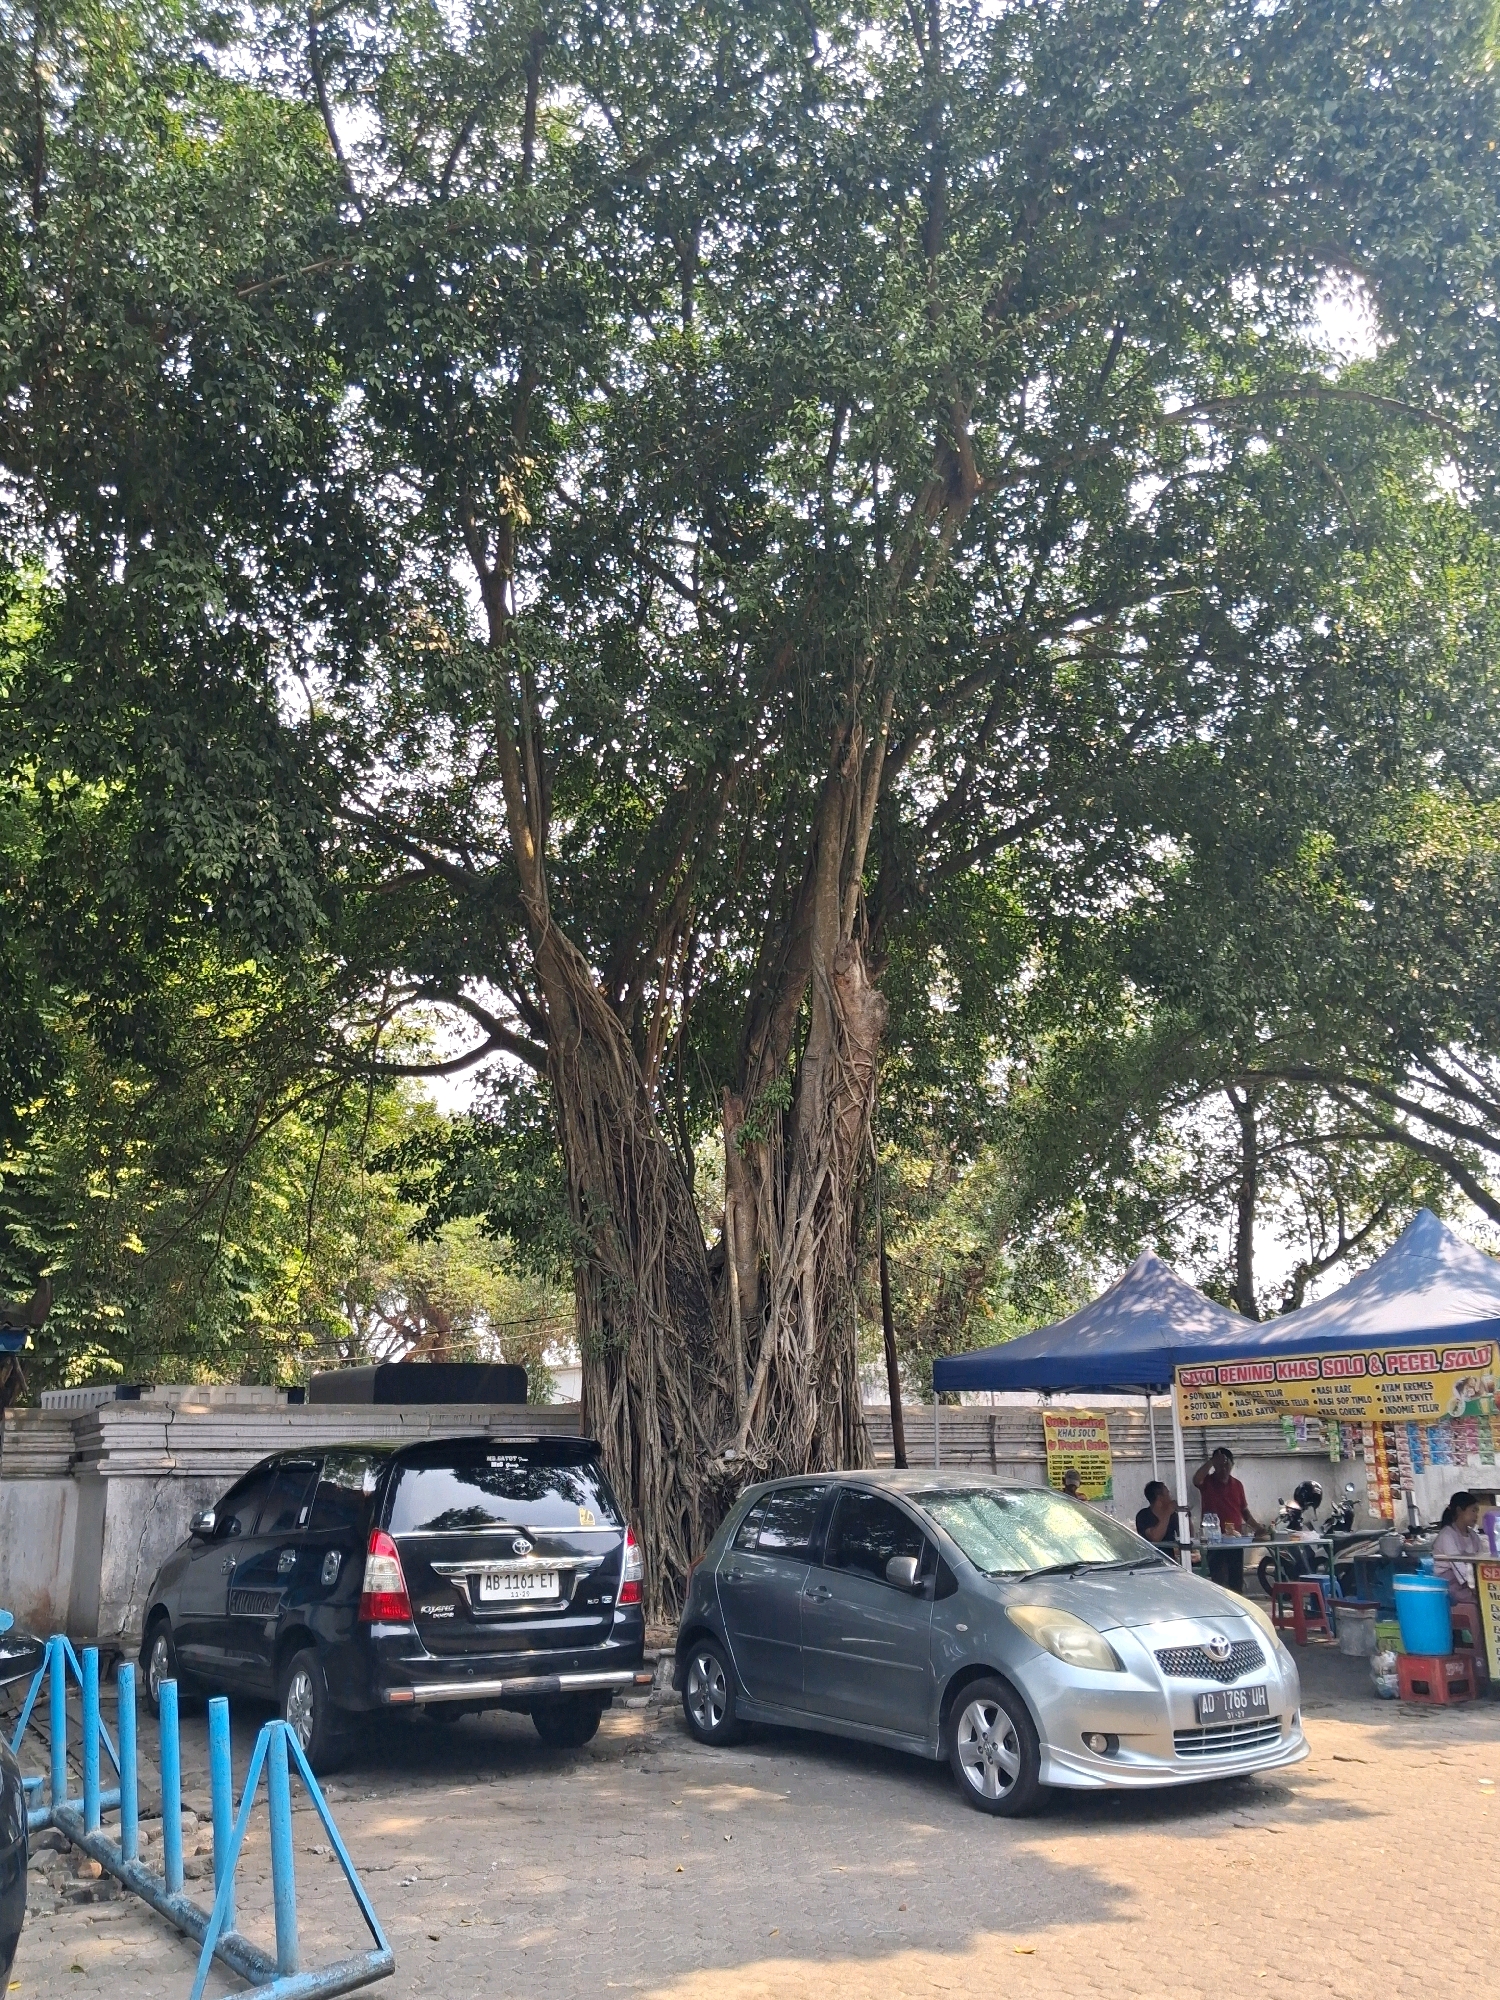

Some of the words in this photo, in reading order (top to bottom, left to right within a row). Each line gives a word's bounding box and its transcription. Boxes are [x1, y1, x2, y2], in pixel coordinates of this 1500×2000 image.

[1180, 1367, 1217, 1387] SOTO
[1218, 1362, 1275, 1385] BENING
[1276, 1358, 1320, 1381] KHAS
[1322, 1355, 1366, 1378] SOLO
[1368, 1353, 1382, 1375] &
[1385, 1350, 1438, 1375] PECEL
[1442, 1345, 1493, 1371] SOLO
[1316, 1386, 1332, 1395] NASI
[1335, 1384, 1352, 1394] KARE
[1381, 1382, 1401, 1392] AYAM
[1403, 1381, 1434, 1391] KREMES
[1235, 1399, 1251, 1407] NASI
[1318, 1397, 1334, 1405] NASI
[1336, 1396, 1350, 1404] SOP
[1351, 1395, 1373, 1404] TIMLO
[1383, 1394, 1403, 1403] AYAM
[1405, 1393, 1433, 1402] PENYET
[1190, 1402, 1207, 1411] SOTO
[1385, 1405, 1415, 1415] INDOMIE
[1418, 1403, 1440, 1413] TELUR
[1191, 1412, 1208, 1421] SOTO
[1237, 1409, 1253, 1417] NASI
[1046, 1416, 1069, 1427] Soto
[1057, 1429, 1076, 1437] KHAS
[1078, 1429, 1096, 1437] SOLO
[486, 1575, 500, 1591] AB
[504, 1573, 535, 1589] 1161
[540, 1573, 555, 1588] ET
[421, 1605, 455, 1614] KIJANG
[1202, 1694, 1215, 1714] AD
[1222, 1689, 1248, 1711] 1766
[1251, 1687, 1266, 1706] UH
